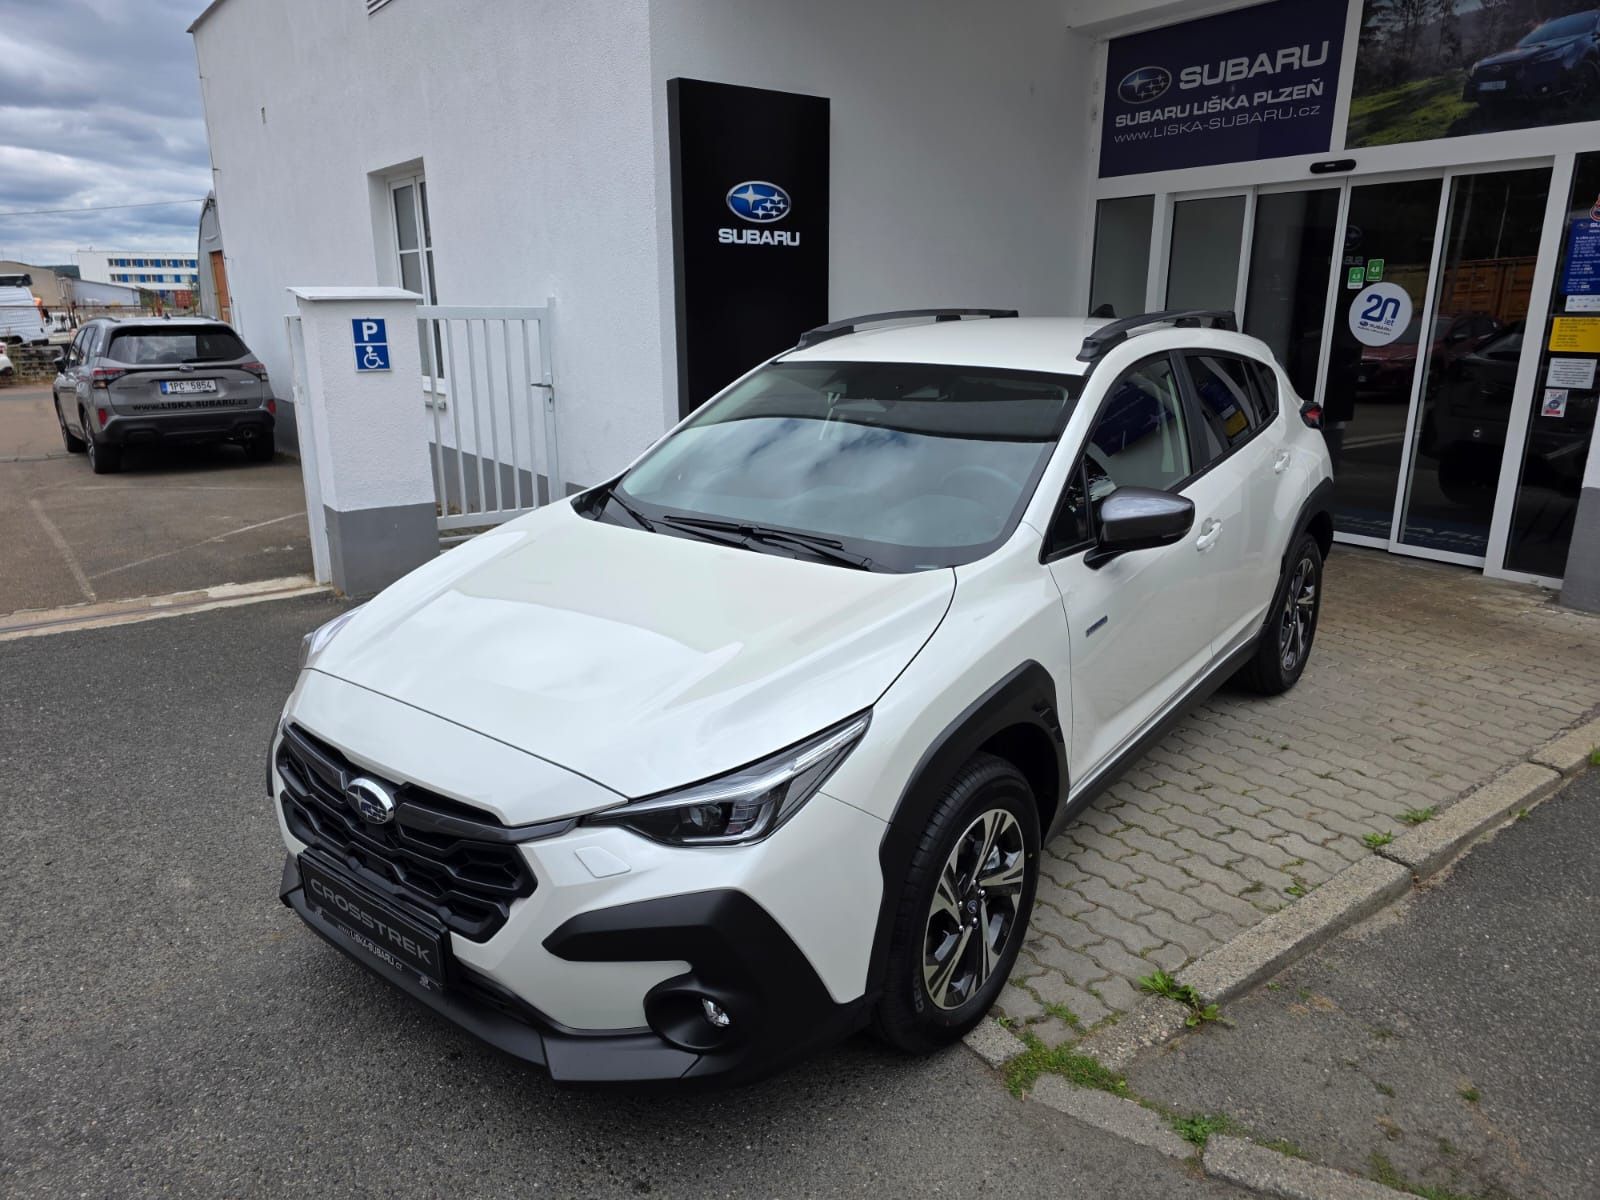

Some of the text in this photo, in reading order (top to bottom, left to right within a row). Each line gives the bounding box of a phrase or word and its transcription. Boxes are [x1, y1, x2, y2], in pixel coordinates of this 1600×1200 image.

[1179, 40, 1329, 90] SUBARU
[1114, 105, 1321, 143] www.LISKA-SUBARU.cz
[1115, 77, 1324, 128] SUBARU LIŠKA PLZEŇ
[718, 228, 800, 246] SUBARU
[362, 321, 378, 341] P
[311, 878, 432, 965] CROSSTREK
